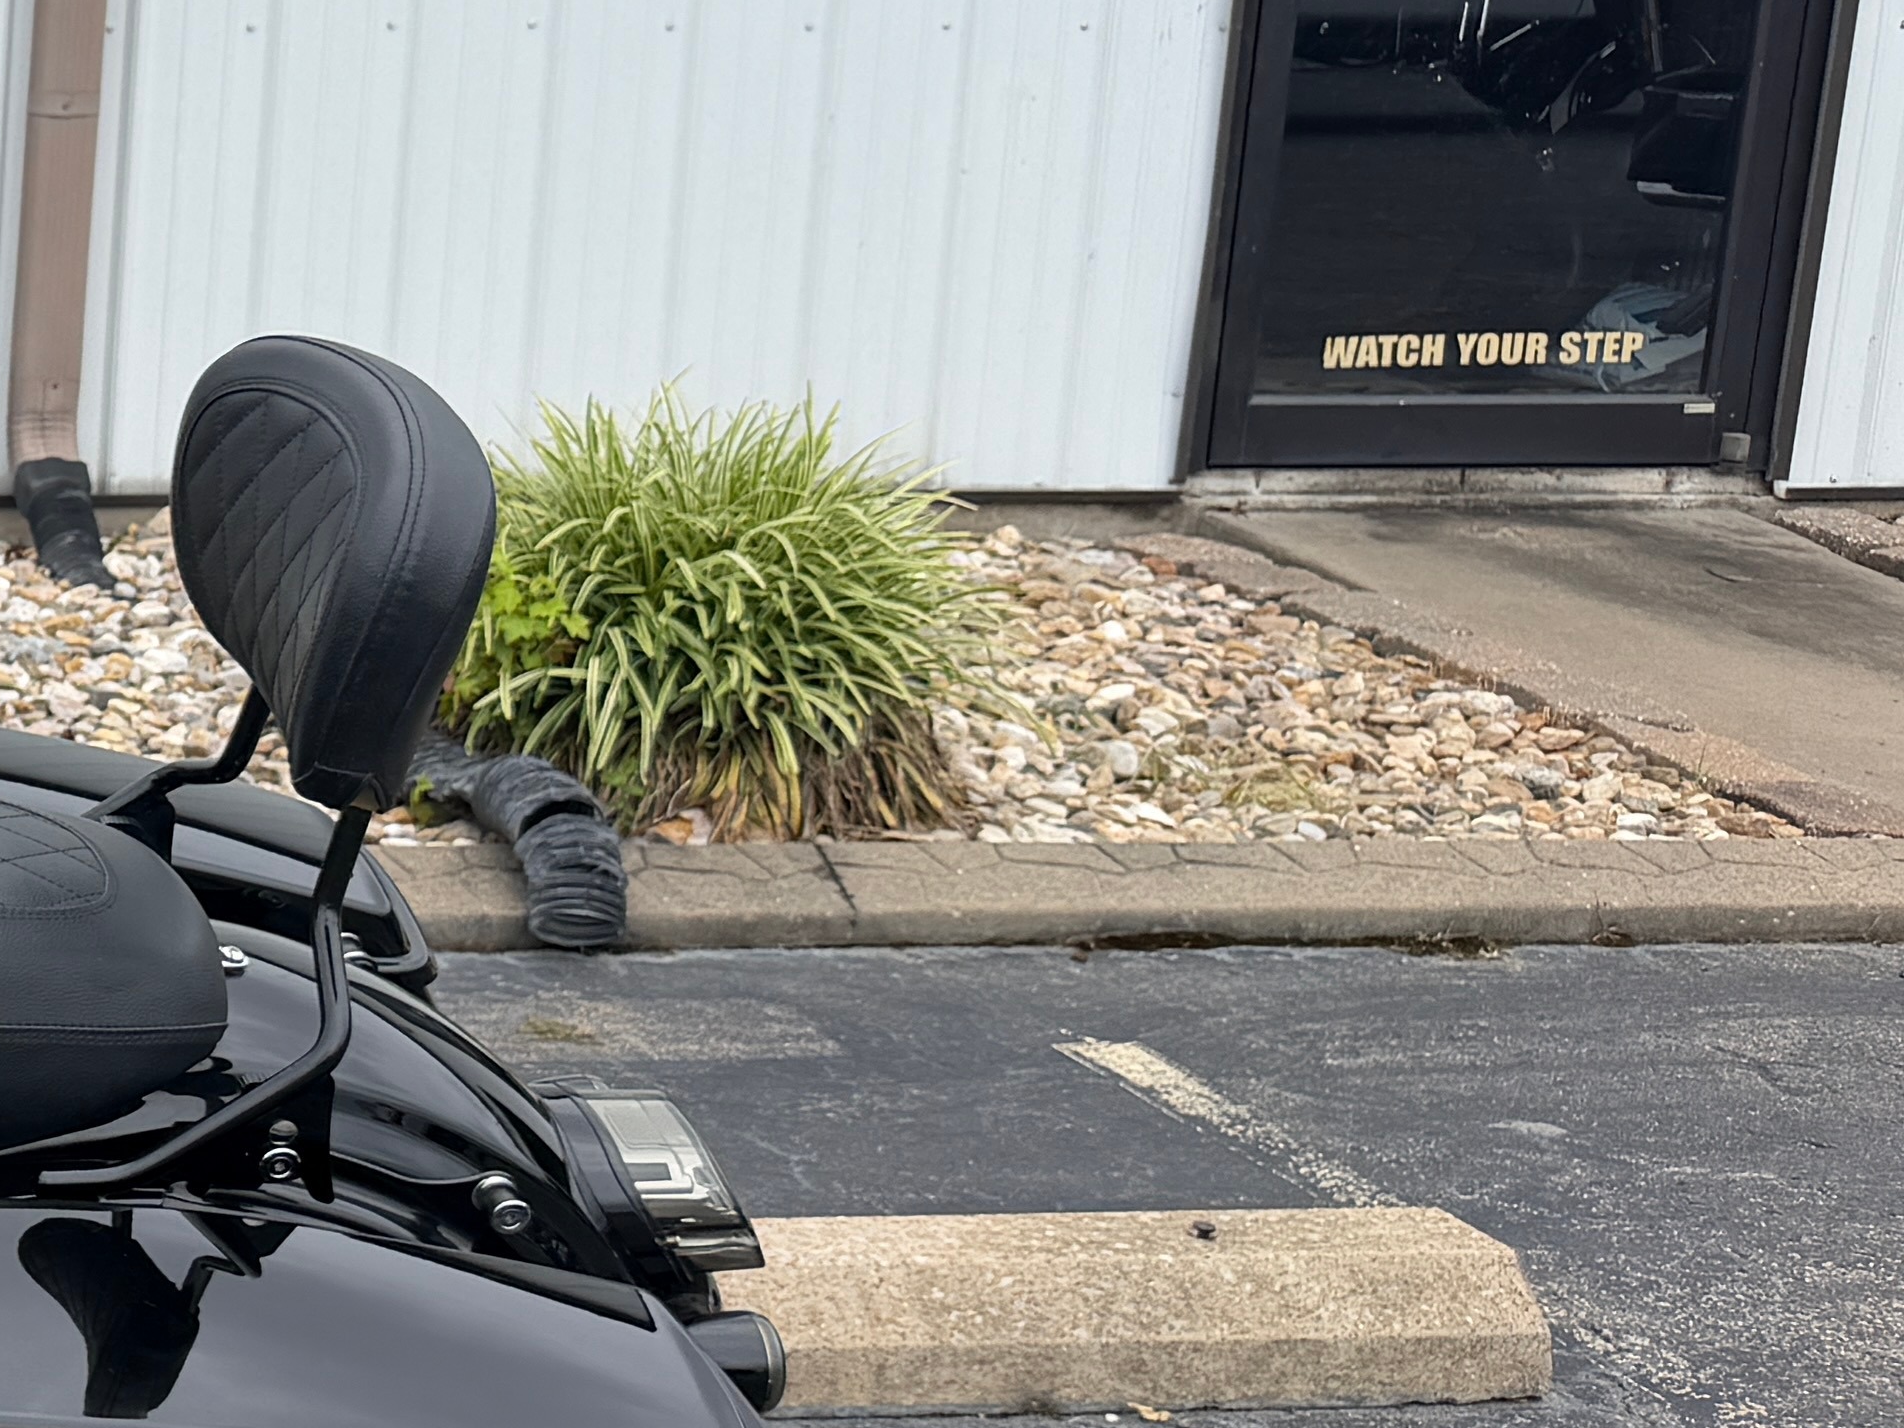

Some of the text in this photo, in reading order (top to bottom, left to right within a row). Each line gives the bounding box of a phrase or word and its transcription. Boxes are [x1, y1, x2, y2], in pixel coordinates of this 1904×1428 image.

[1323, 331, 1644, 369] WATCH YOUR STEP
